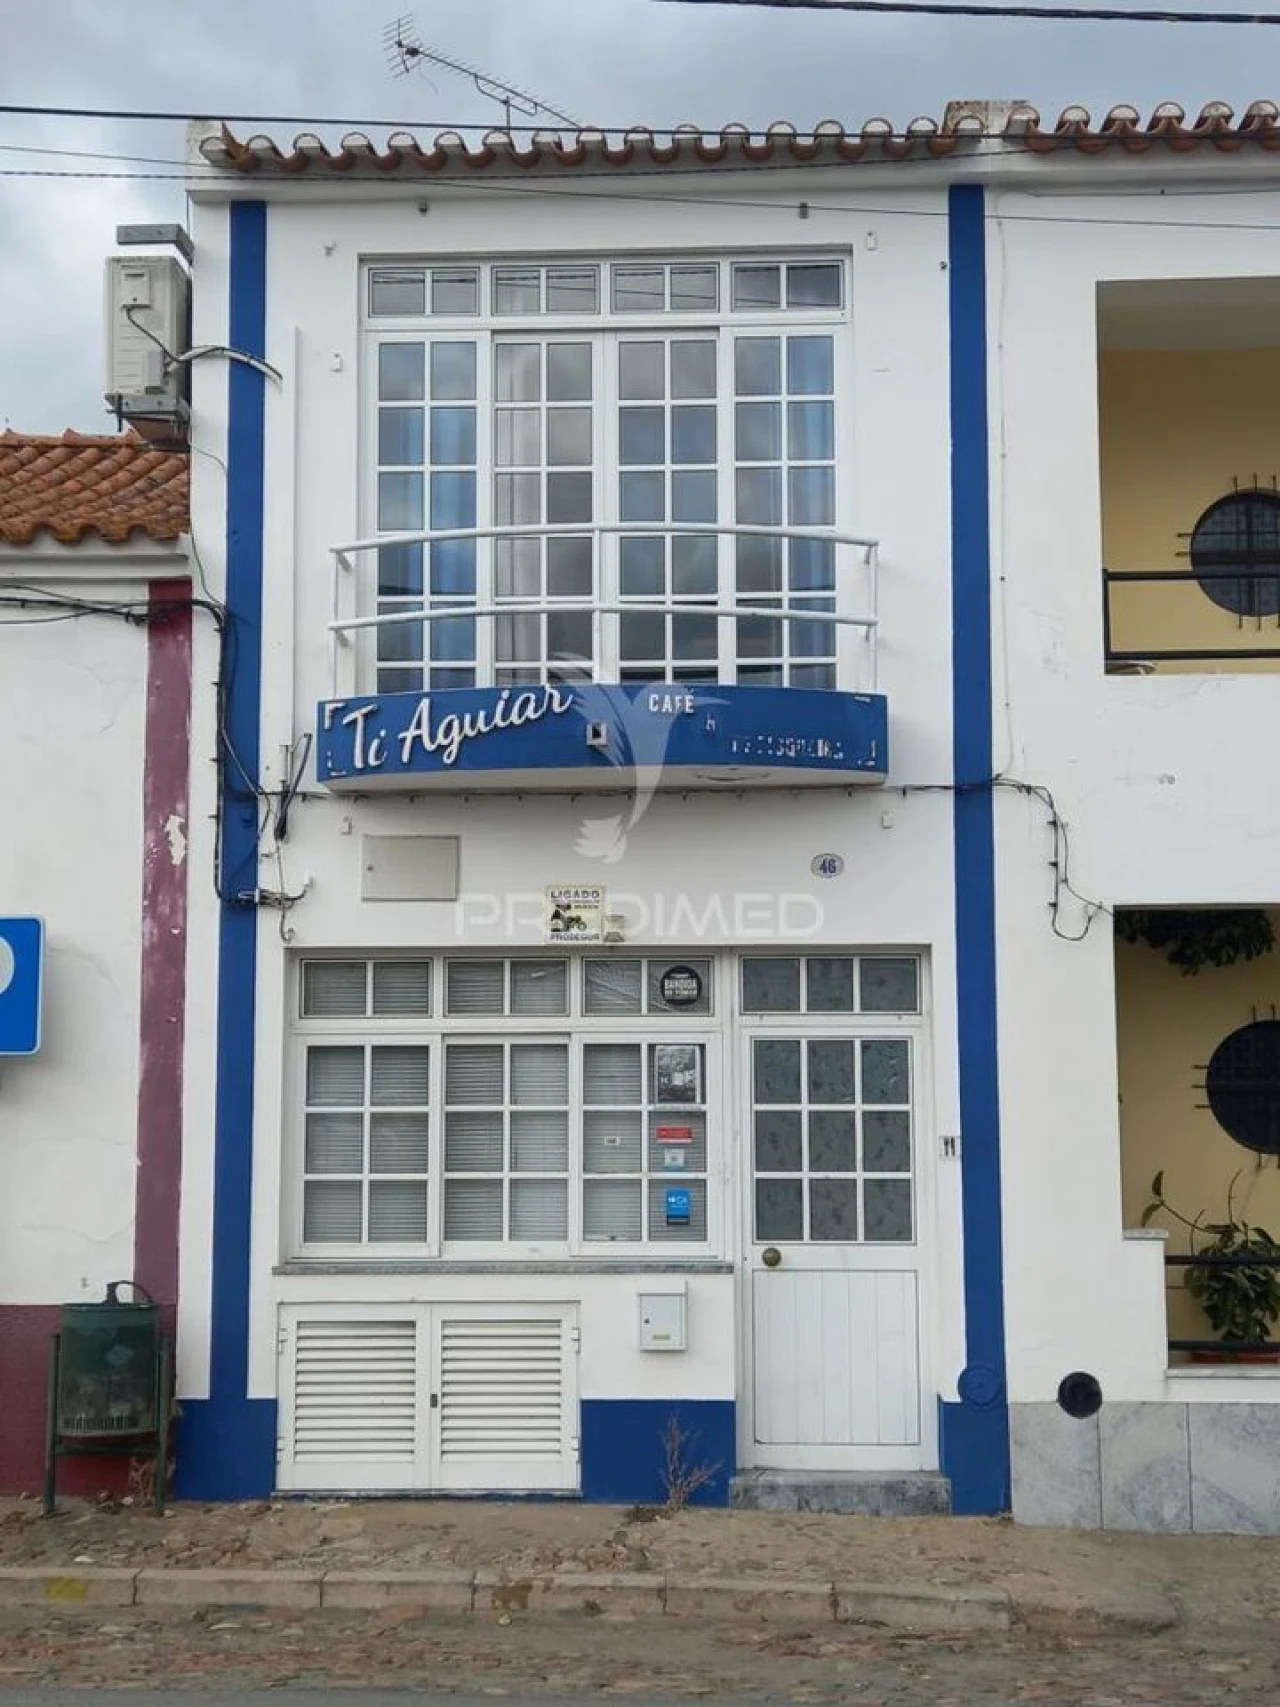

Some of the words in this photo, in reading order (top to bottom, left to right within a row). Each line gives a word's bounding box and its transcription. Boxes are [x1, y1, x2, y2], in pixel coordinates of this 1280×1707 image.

[342, 703, 387, 768] Ti
[398, 682, 574, 764] Aguiar
[819, 858, 837, 874] 46
[550, 890, 600, 899] LIGADO
